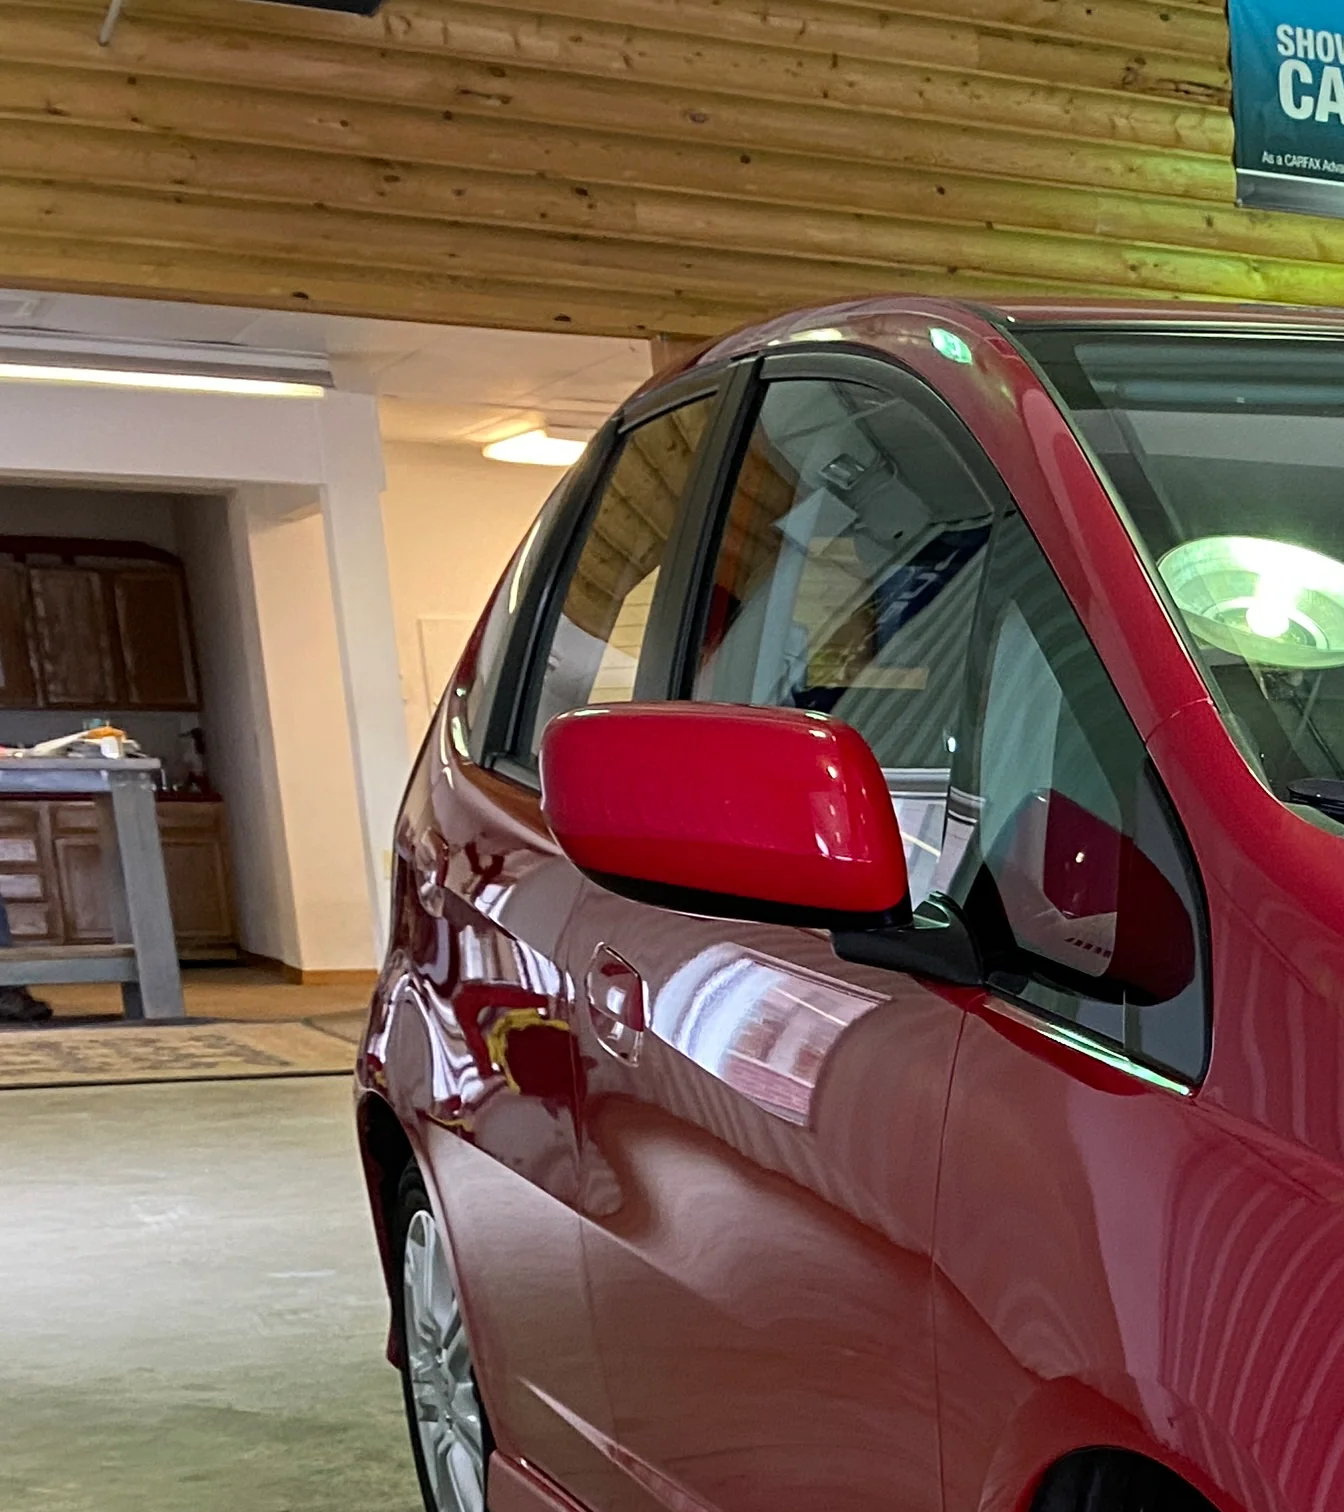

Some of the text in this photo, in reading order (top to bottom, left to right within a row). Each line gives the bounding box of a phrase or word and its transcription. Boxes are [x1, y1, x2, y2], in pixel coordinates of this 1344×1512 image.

[1262, 151, 1274, 164] As
[1276, 155, 1283, 166] a
[1284, 154, 1321, 169] CARFAX
